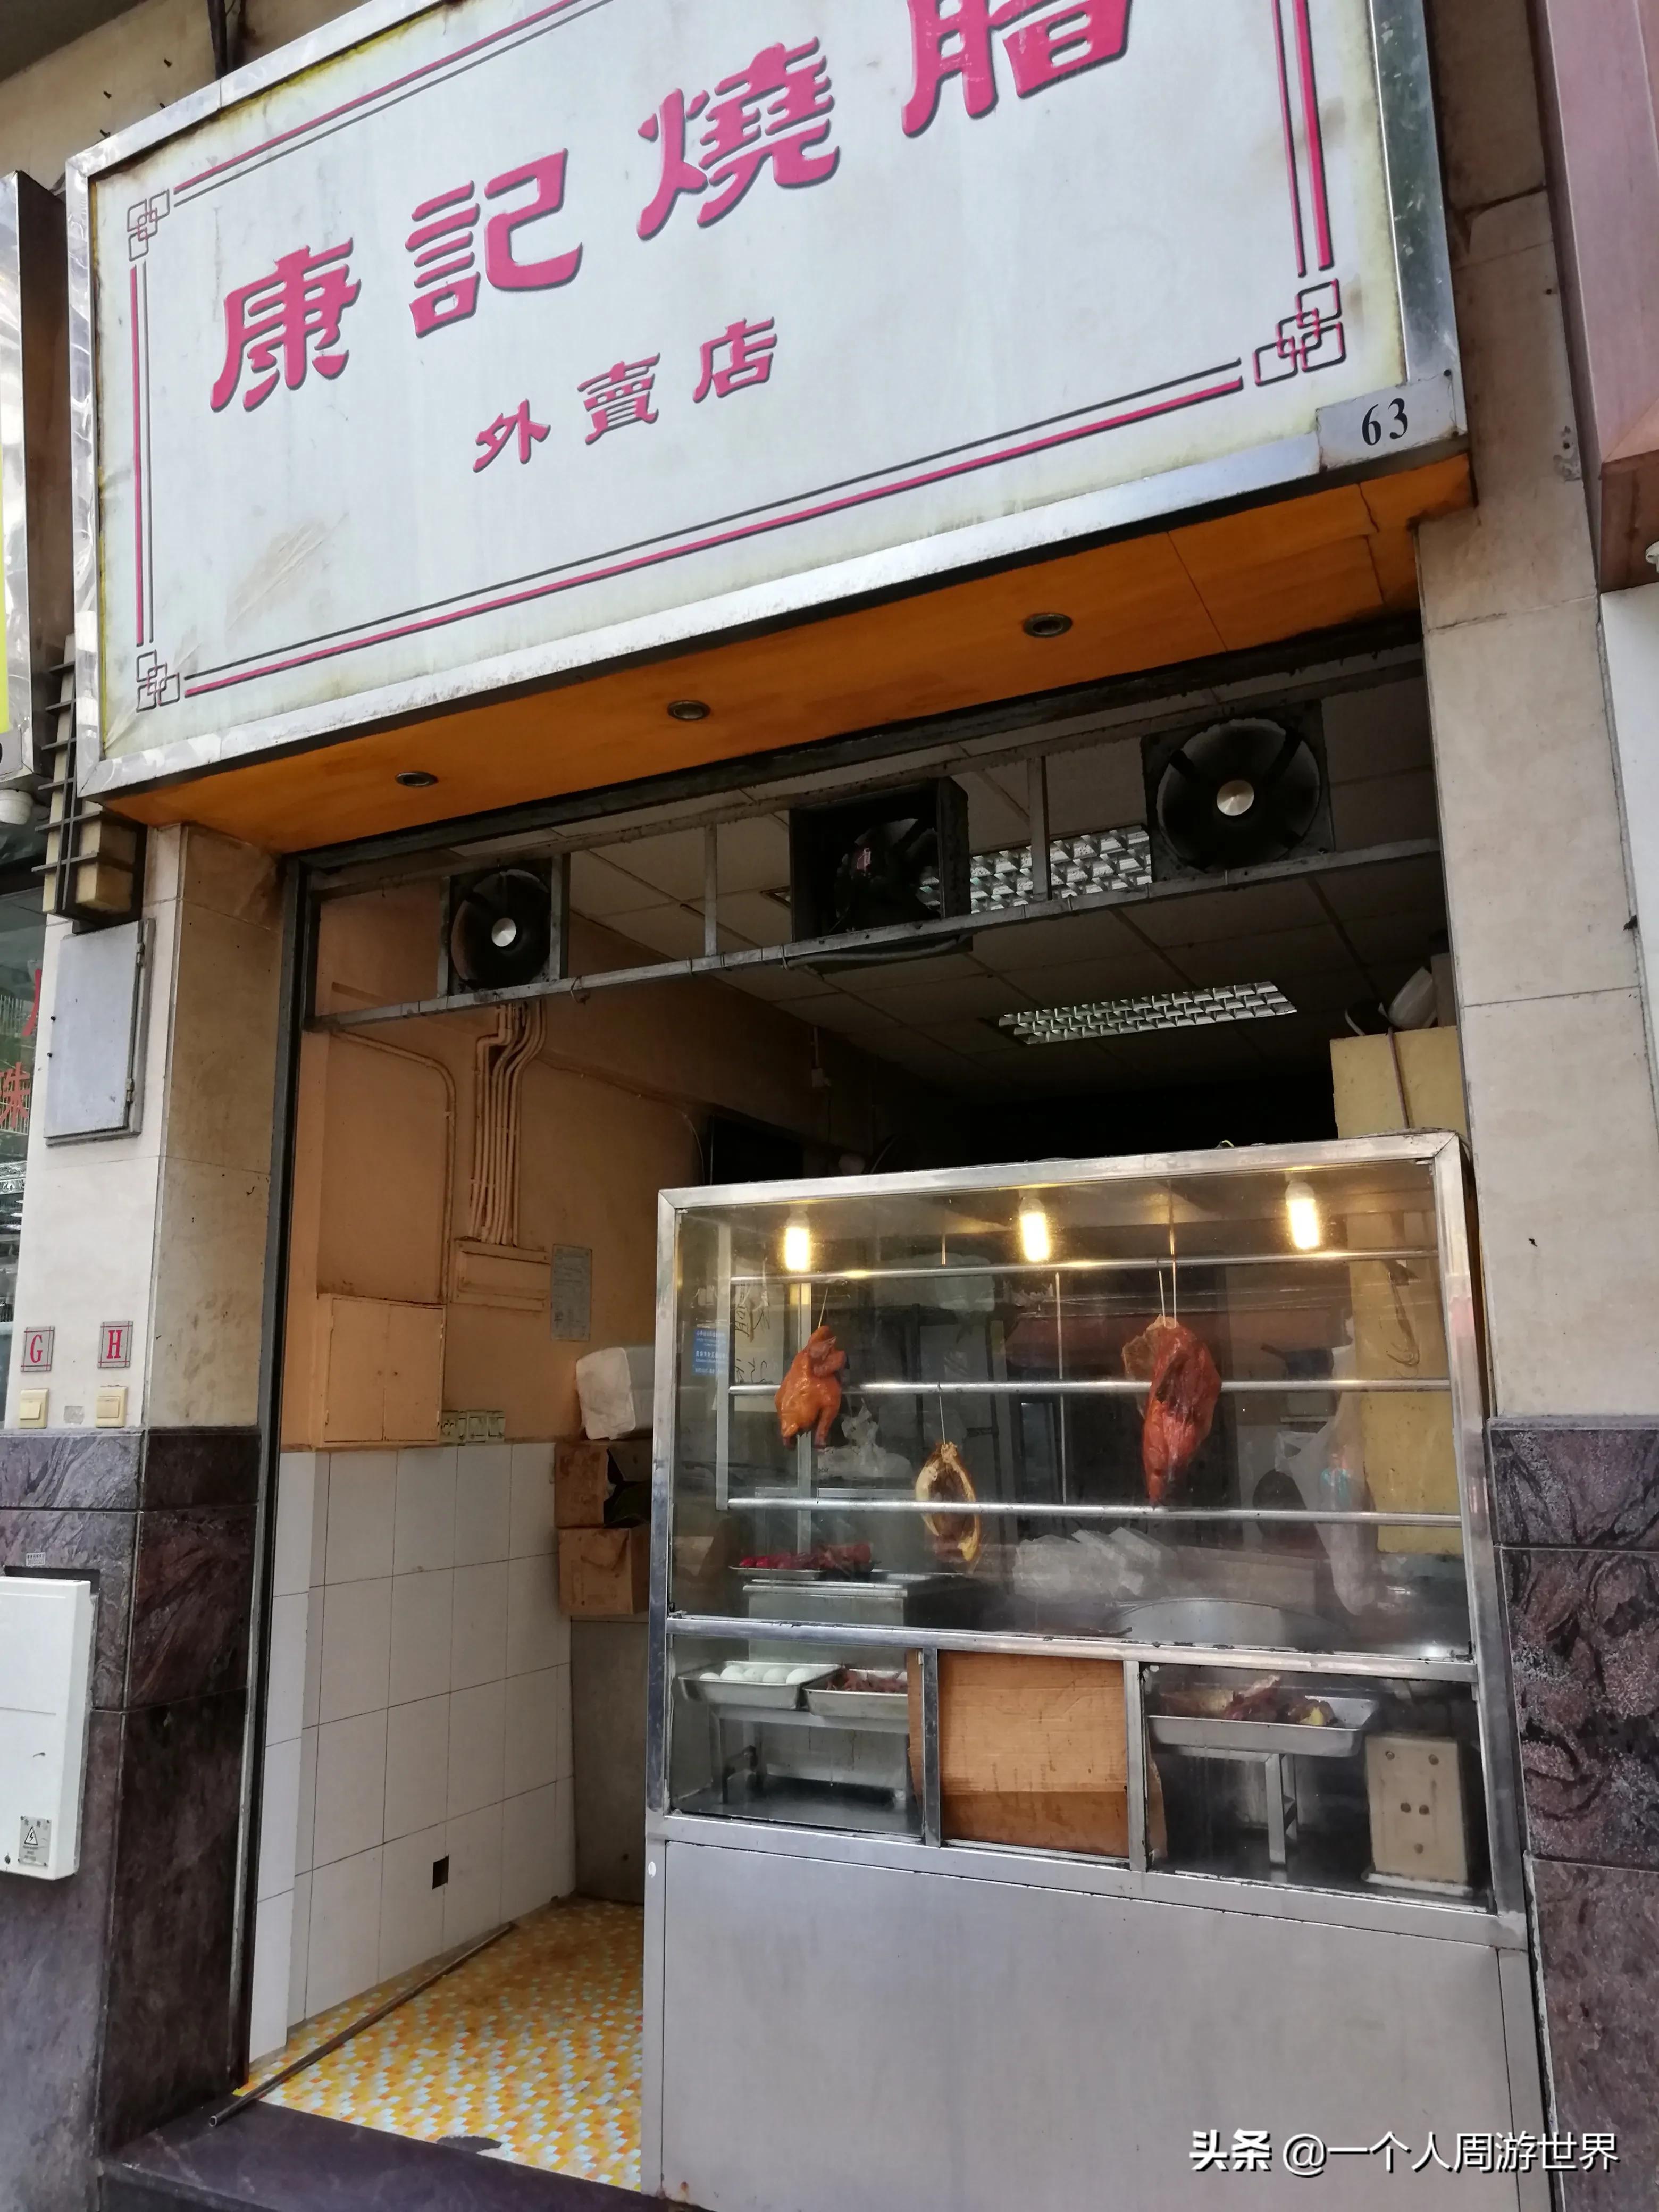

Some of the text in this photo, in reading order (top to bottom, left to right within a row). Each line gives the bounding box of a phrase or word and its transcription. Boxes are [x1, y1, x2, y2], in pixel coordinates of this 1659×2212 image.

[473, 317, 777, 473] 外賣店
[1362, 398, 1408, 446] 63
[30, 1334, 43, 1363] G
[106, 1329, 123, 1359] H
